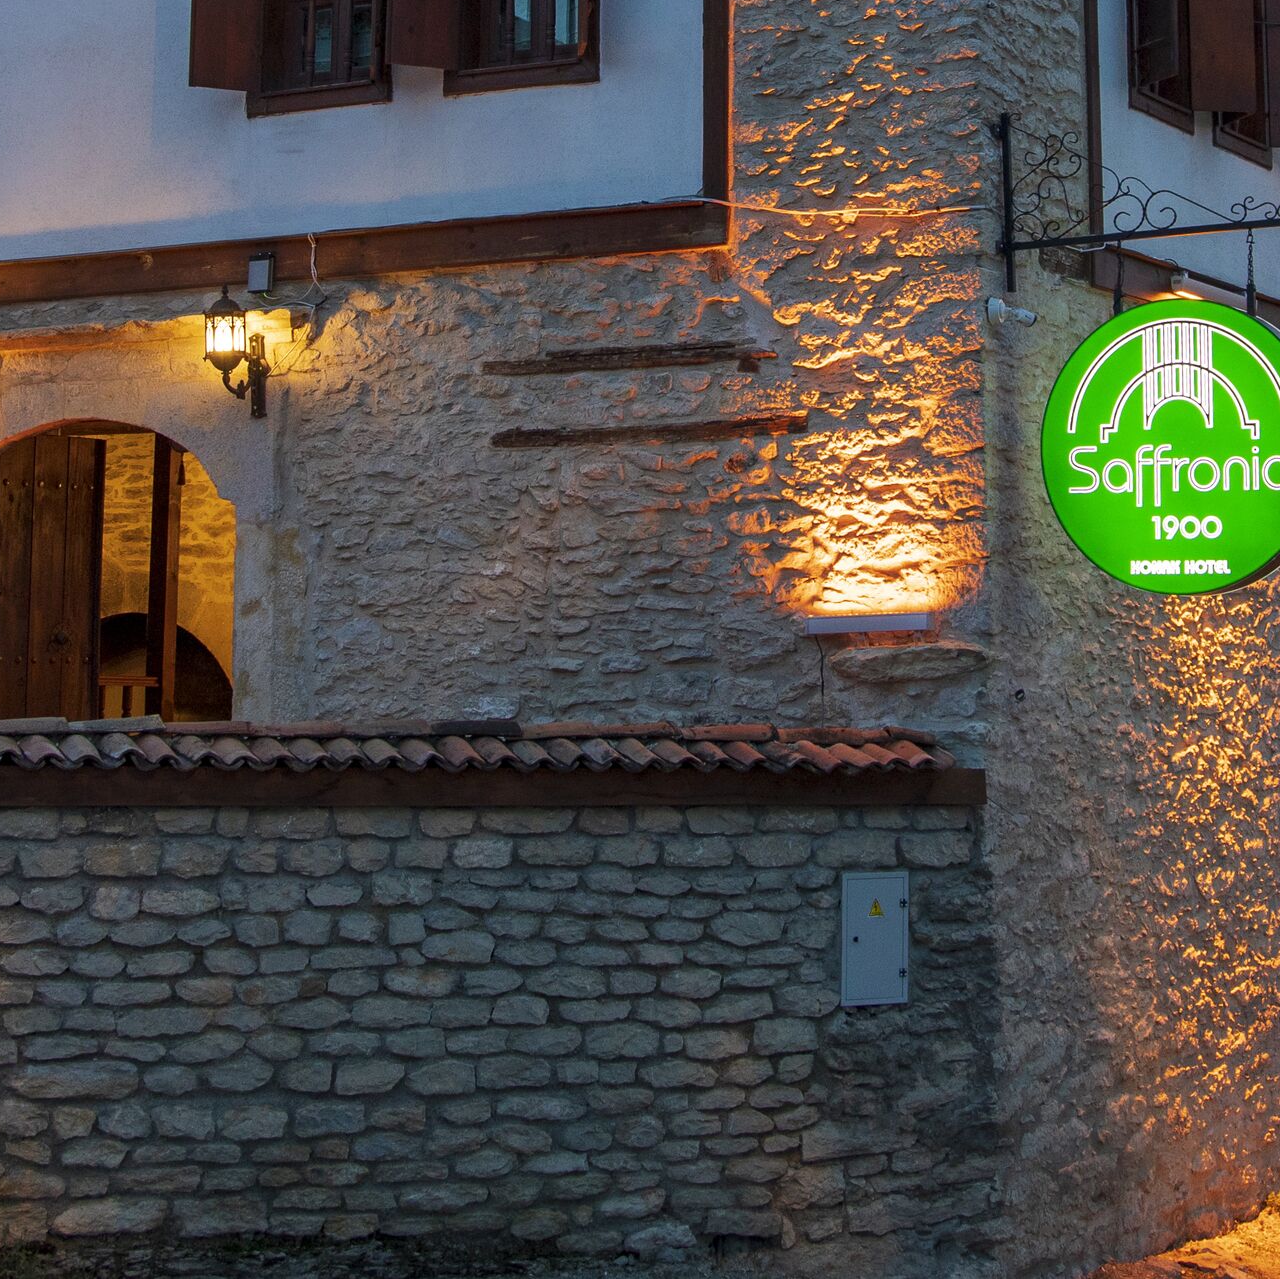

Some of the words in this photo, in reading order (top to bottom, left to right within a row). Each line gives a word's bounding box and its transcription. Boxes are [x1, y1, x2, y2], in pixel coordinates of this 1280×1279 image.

[1151, 515, 1223, 540] 1900
[1130, 560, 1181, 575] KONAK
[1184, 560, 1232, 575] HOTEL
